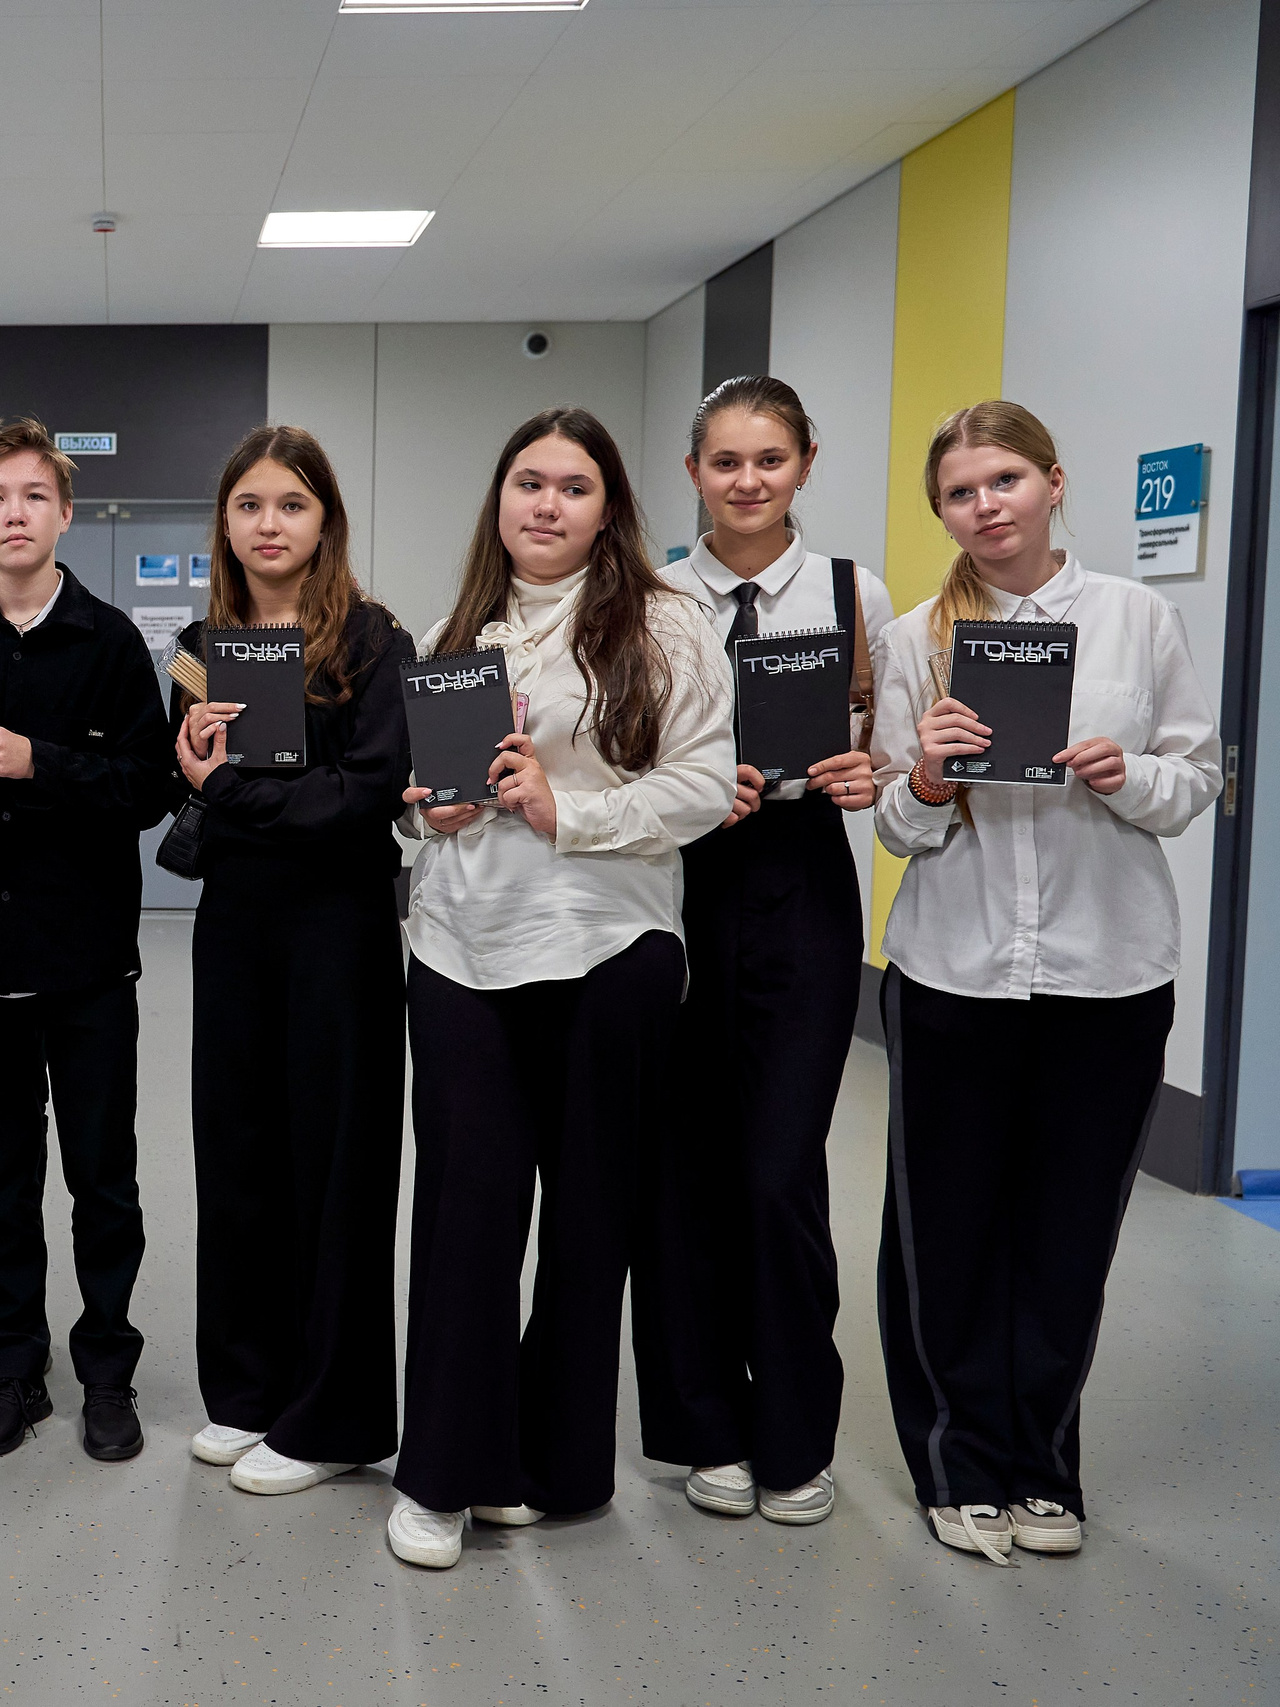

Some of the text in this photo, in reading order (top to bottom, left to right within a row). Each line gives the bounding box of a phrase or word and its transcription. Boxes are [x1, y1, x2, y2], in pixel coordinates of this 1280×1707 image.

[60, 437, 111, 450] ВЫХОД
[1141, 460, 1169, 474] ВОСТОК
[1140, 475, 1175, 513] 219
[213, 642, 300, 658] ТОЧКА
[963, 640, 1069, 659] ТОЧКА
[742, 647, 839, 673] ТОЧКА
[407, 664, 499, 692] ТОЧКА
